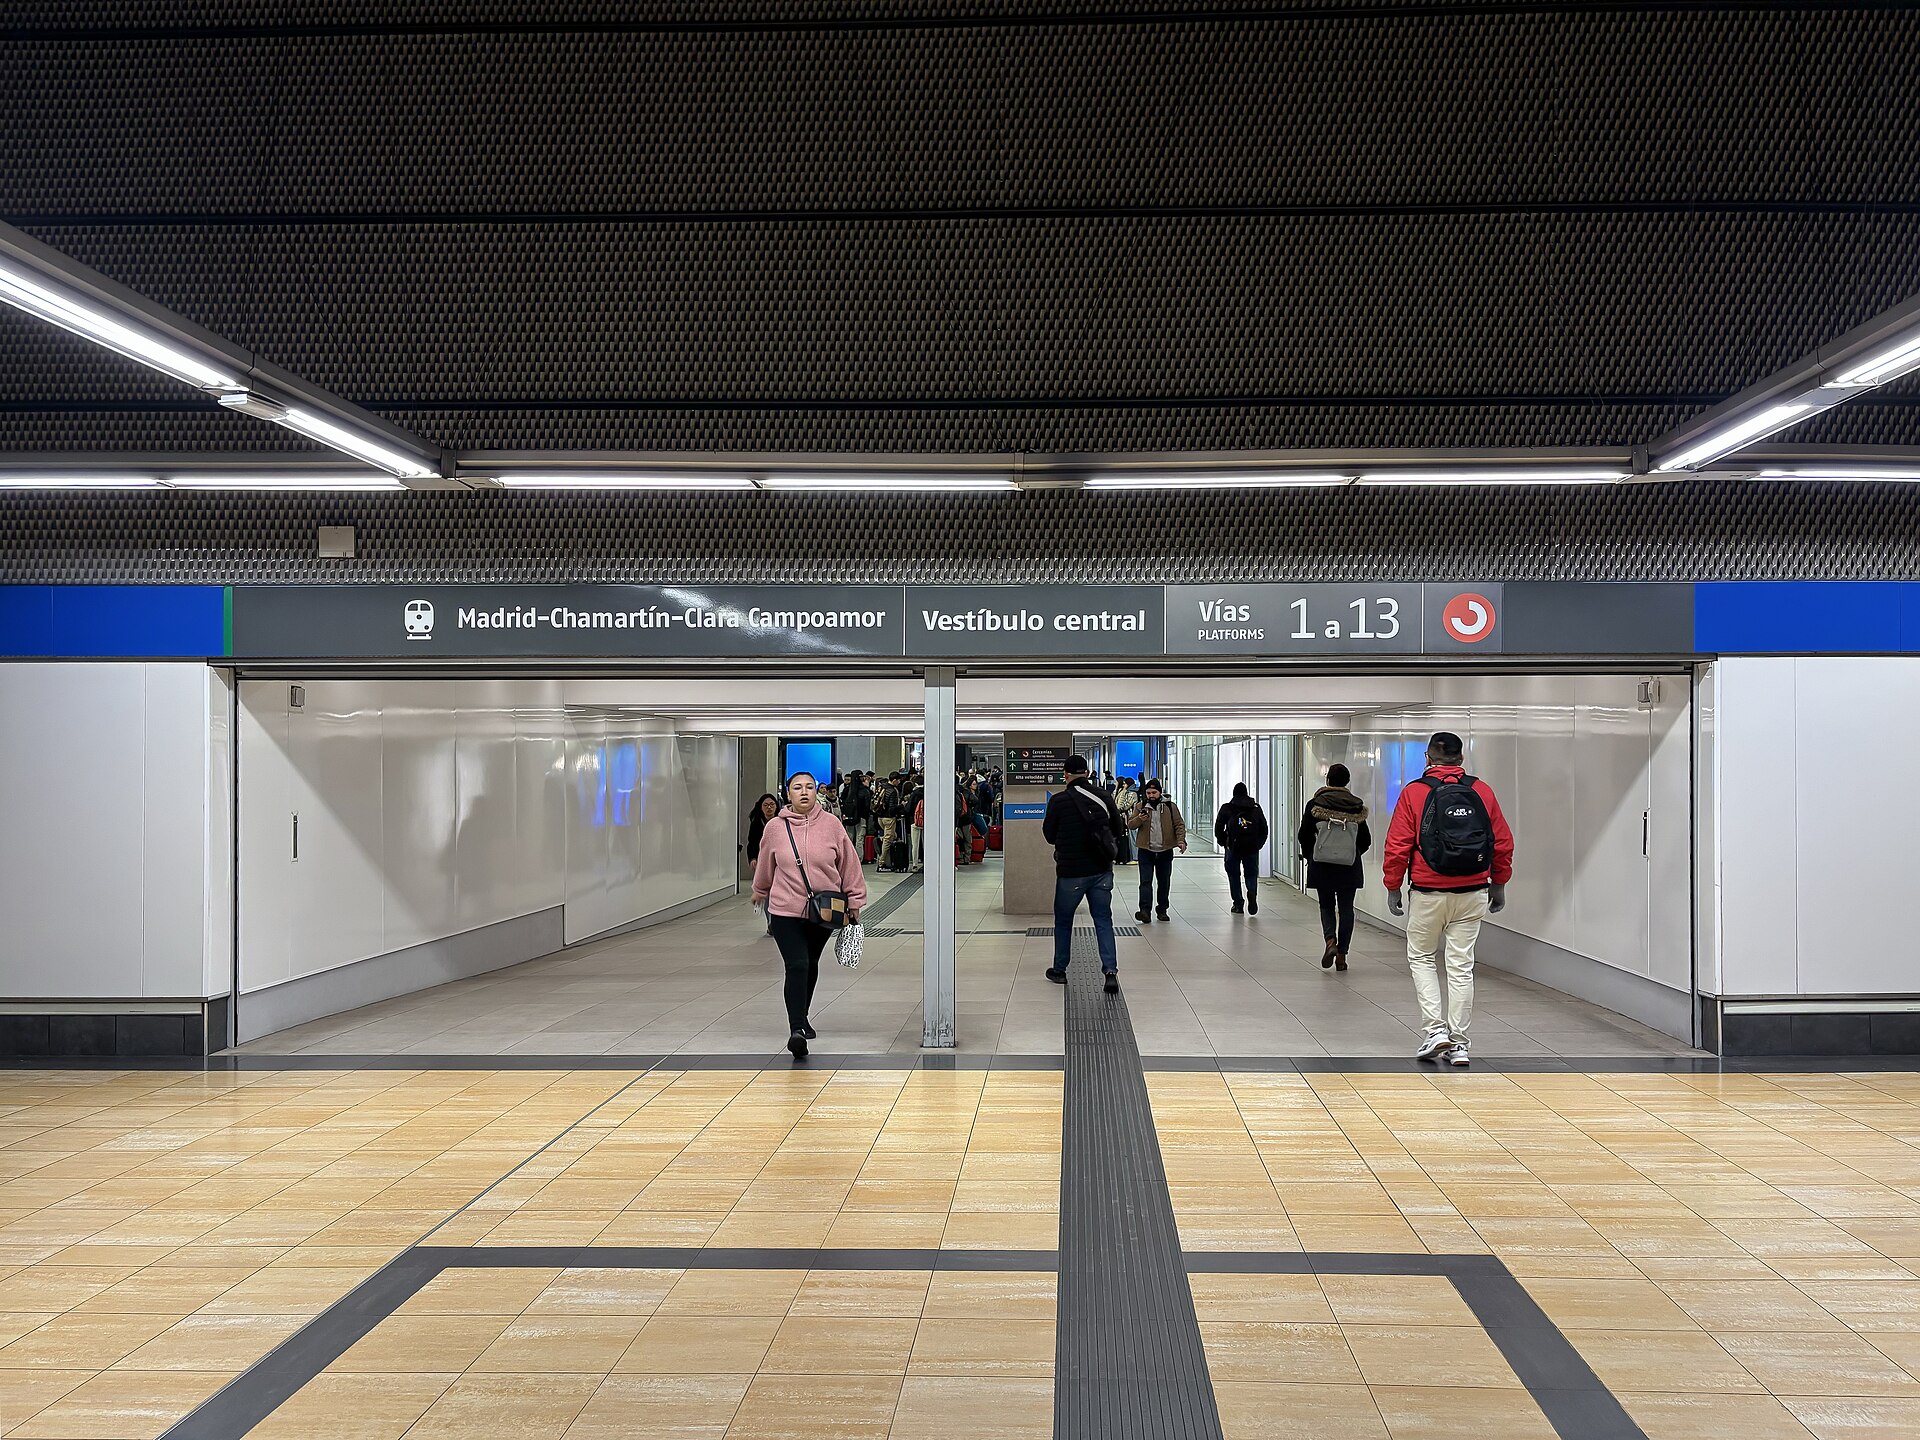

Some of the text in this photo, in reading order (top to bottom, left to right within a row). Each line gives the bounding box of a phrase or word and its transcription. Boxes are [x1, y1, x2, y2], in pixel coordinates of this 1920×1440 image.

[457, 604, 886, 632] Madrid-Chamartín-Clara Campoamor
[922, 608, 1145, 631] Vestíbulo central
[1198, 600, 1251, 622] Vías
[1289, 597, 1400, 639] 1 a 13
[1198, 628, 1265, 641] PLATFORMS
